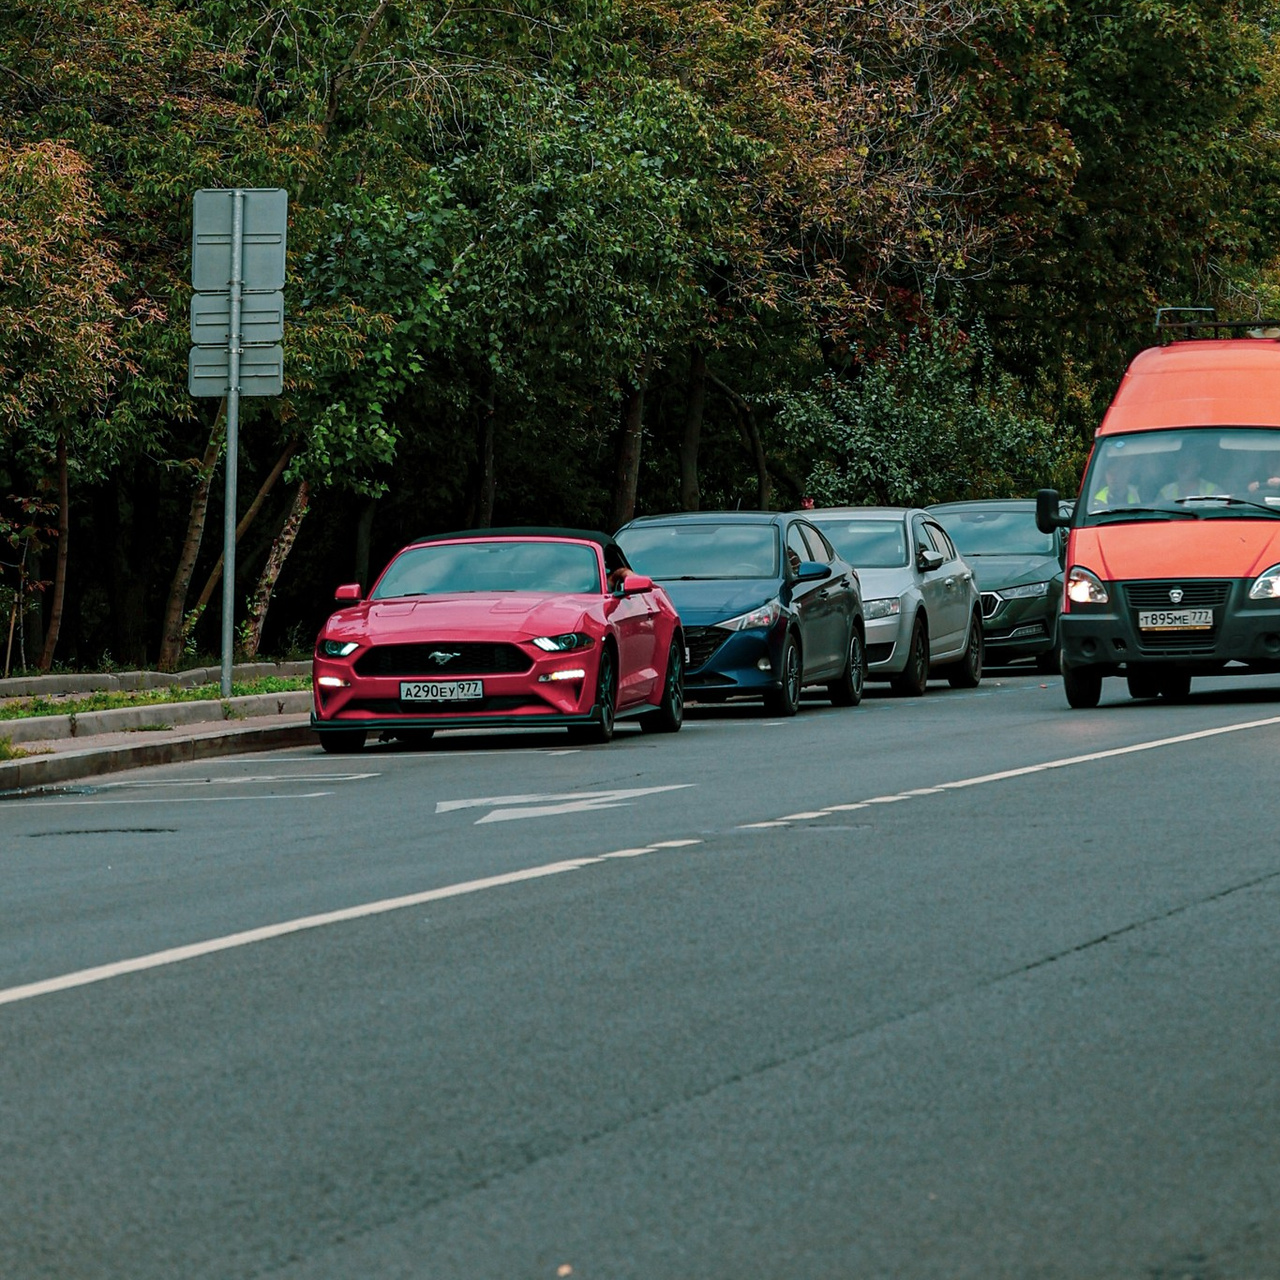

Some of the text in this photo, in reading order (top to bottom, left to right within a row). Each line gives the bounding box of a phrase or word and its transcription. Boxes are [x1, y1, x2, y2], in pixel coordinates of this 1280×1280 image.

[1143, 611, 1210, 626] Т895МЕ 777
[405, 682, 479, 698] А290ЕУ 977
